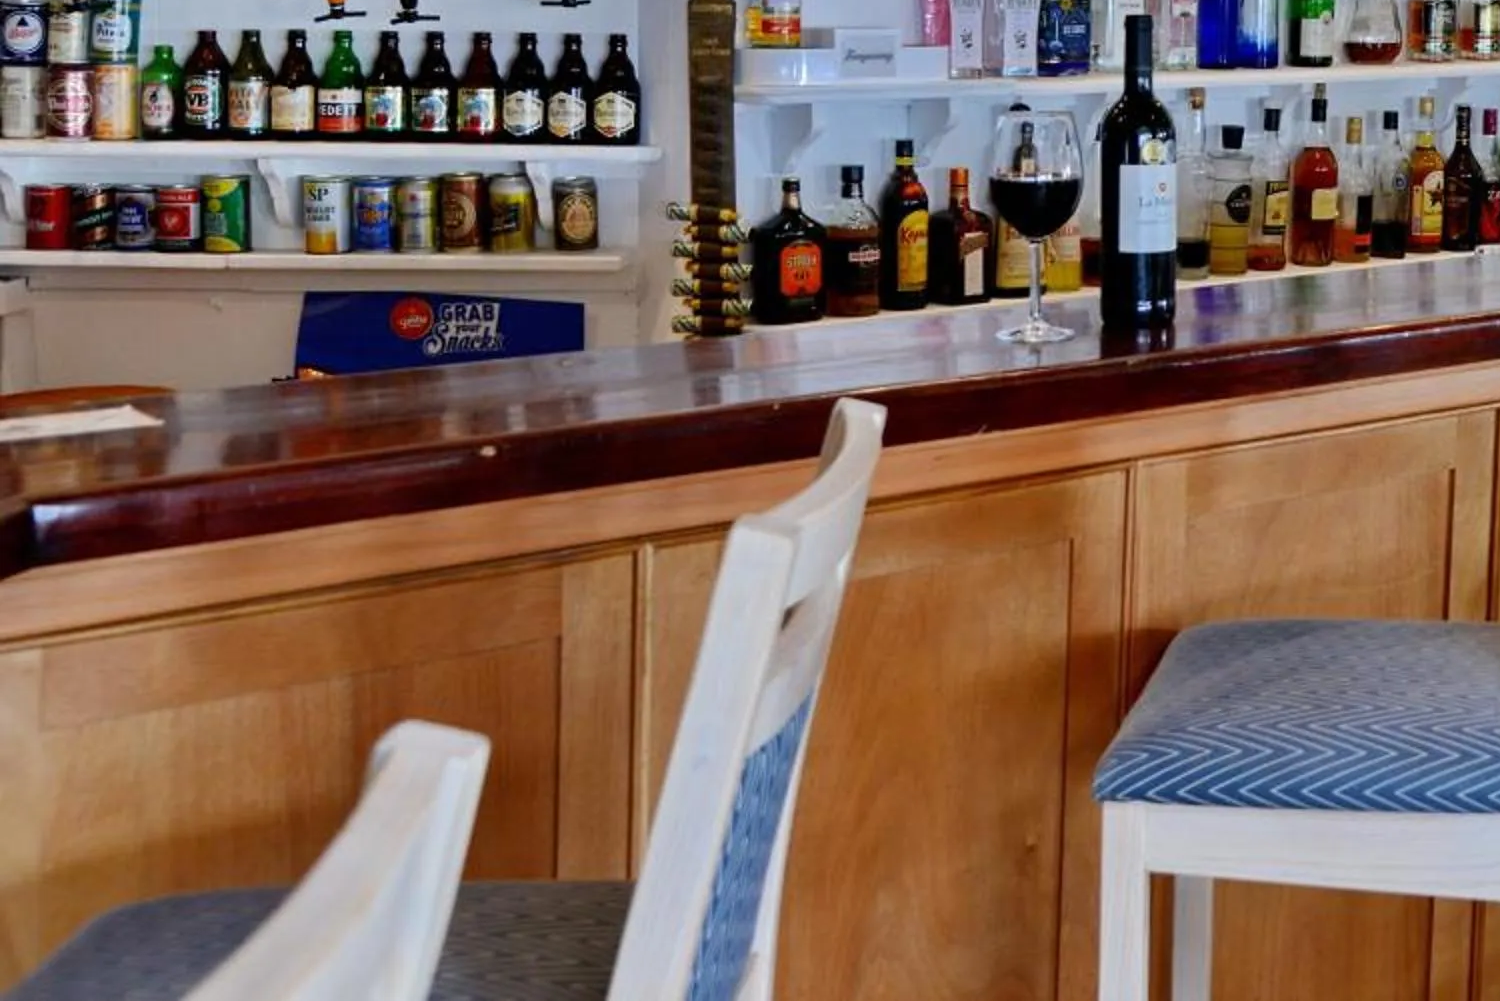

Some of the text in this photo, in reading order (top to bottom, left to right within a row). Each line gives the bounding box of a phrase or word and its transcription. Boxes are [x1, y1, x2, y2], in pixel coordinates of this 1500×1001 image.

[187, 93, 209, 107] VB
[319, 104, 358, 117] EDETT
[440, 302, 495, 322] GRAB
[423, 321, 506, 357] Snacks
